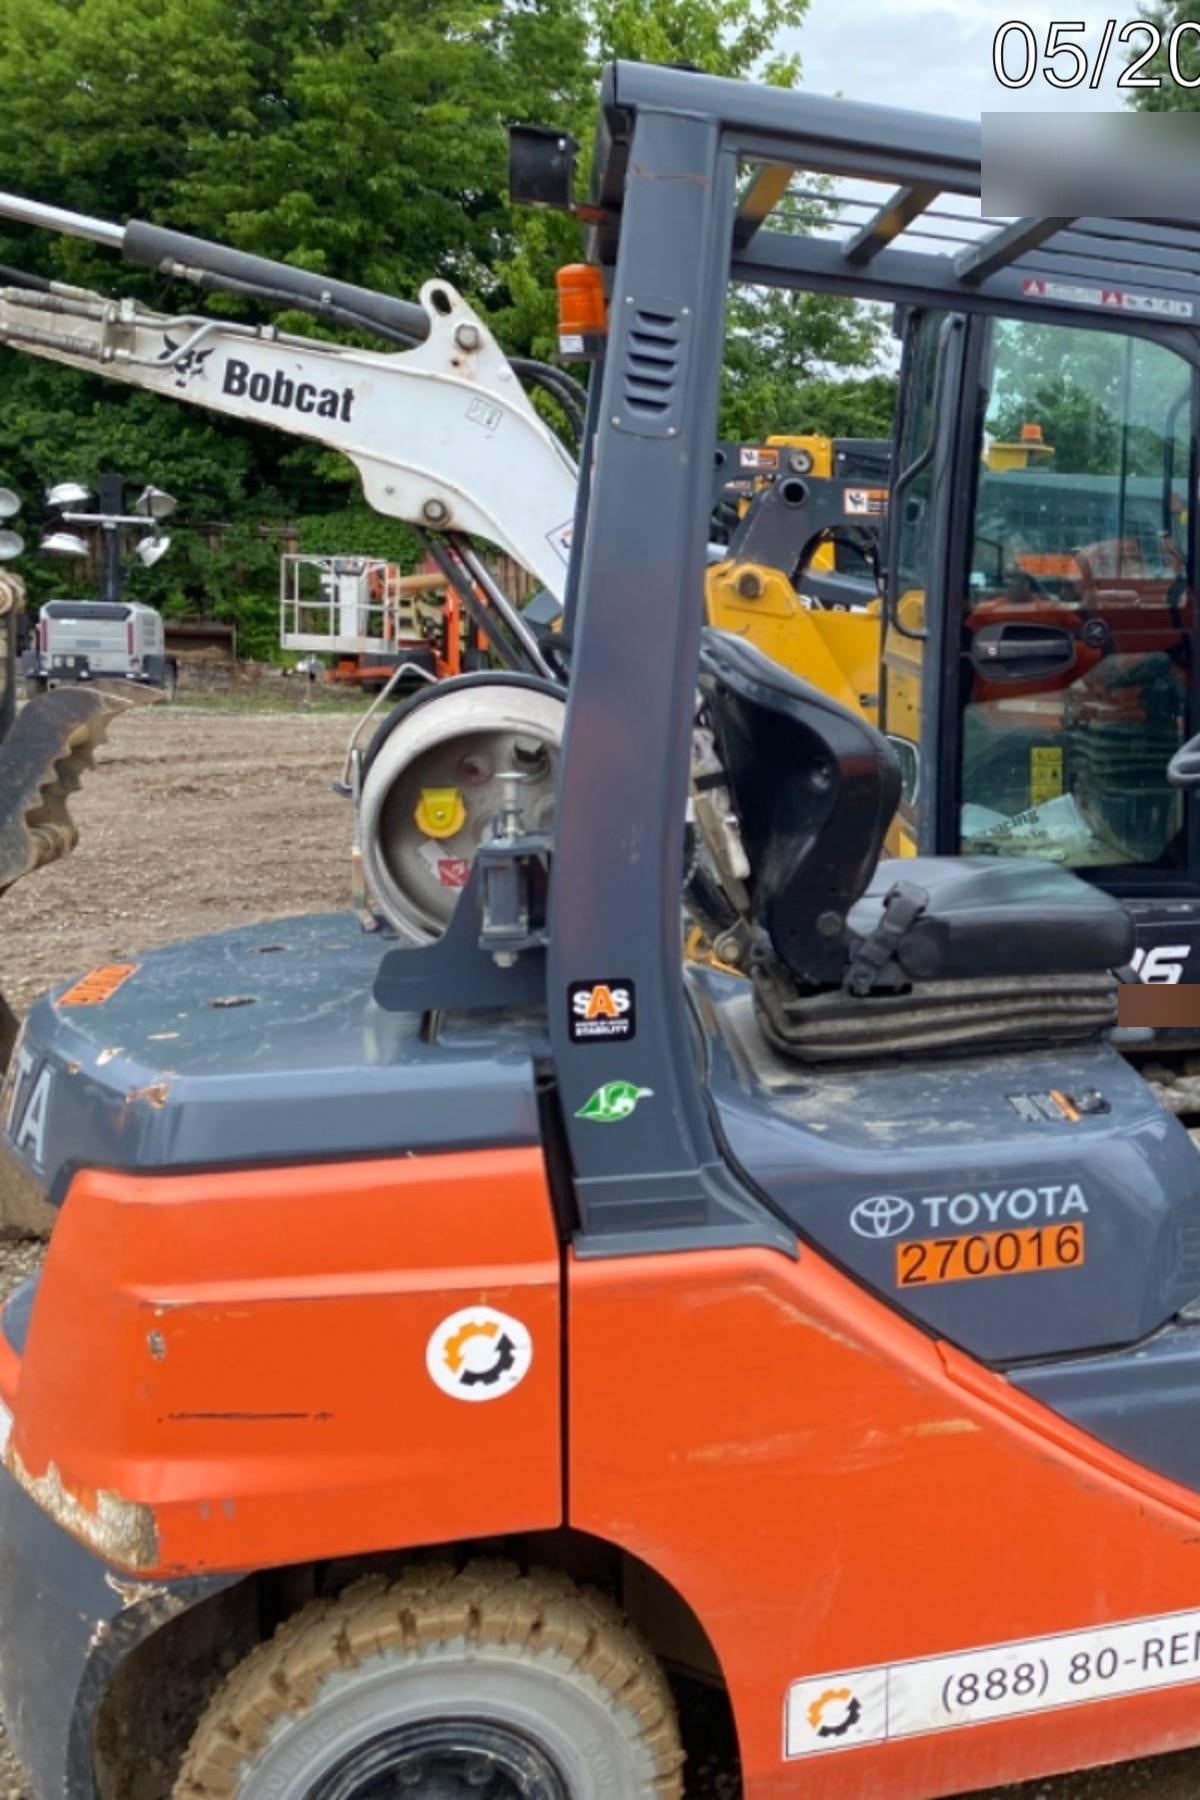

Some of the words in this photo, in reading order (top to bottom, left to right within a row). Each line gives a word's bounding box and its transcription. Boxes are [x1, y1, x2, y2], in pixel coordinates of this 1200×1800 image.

[223, 358, 354, 423] Bobcat
[573, 985, 630, 1019] SAS
[921, 1184, 1089, 1227] TOYOTA
[901, 1225, 1079, 1284] 270016
[942, 1659, 1049, 1712] (888)
